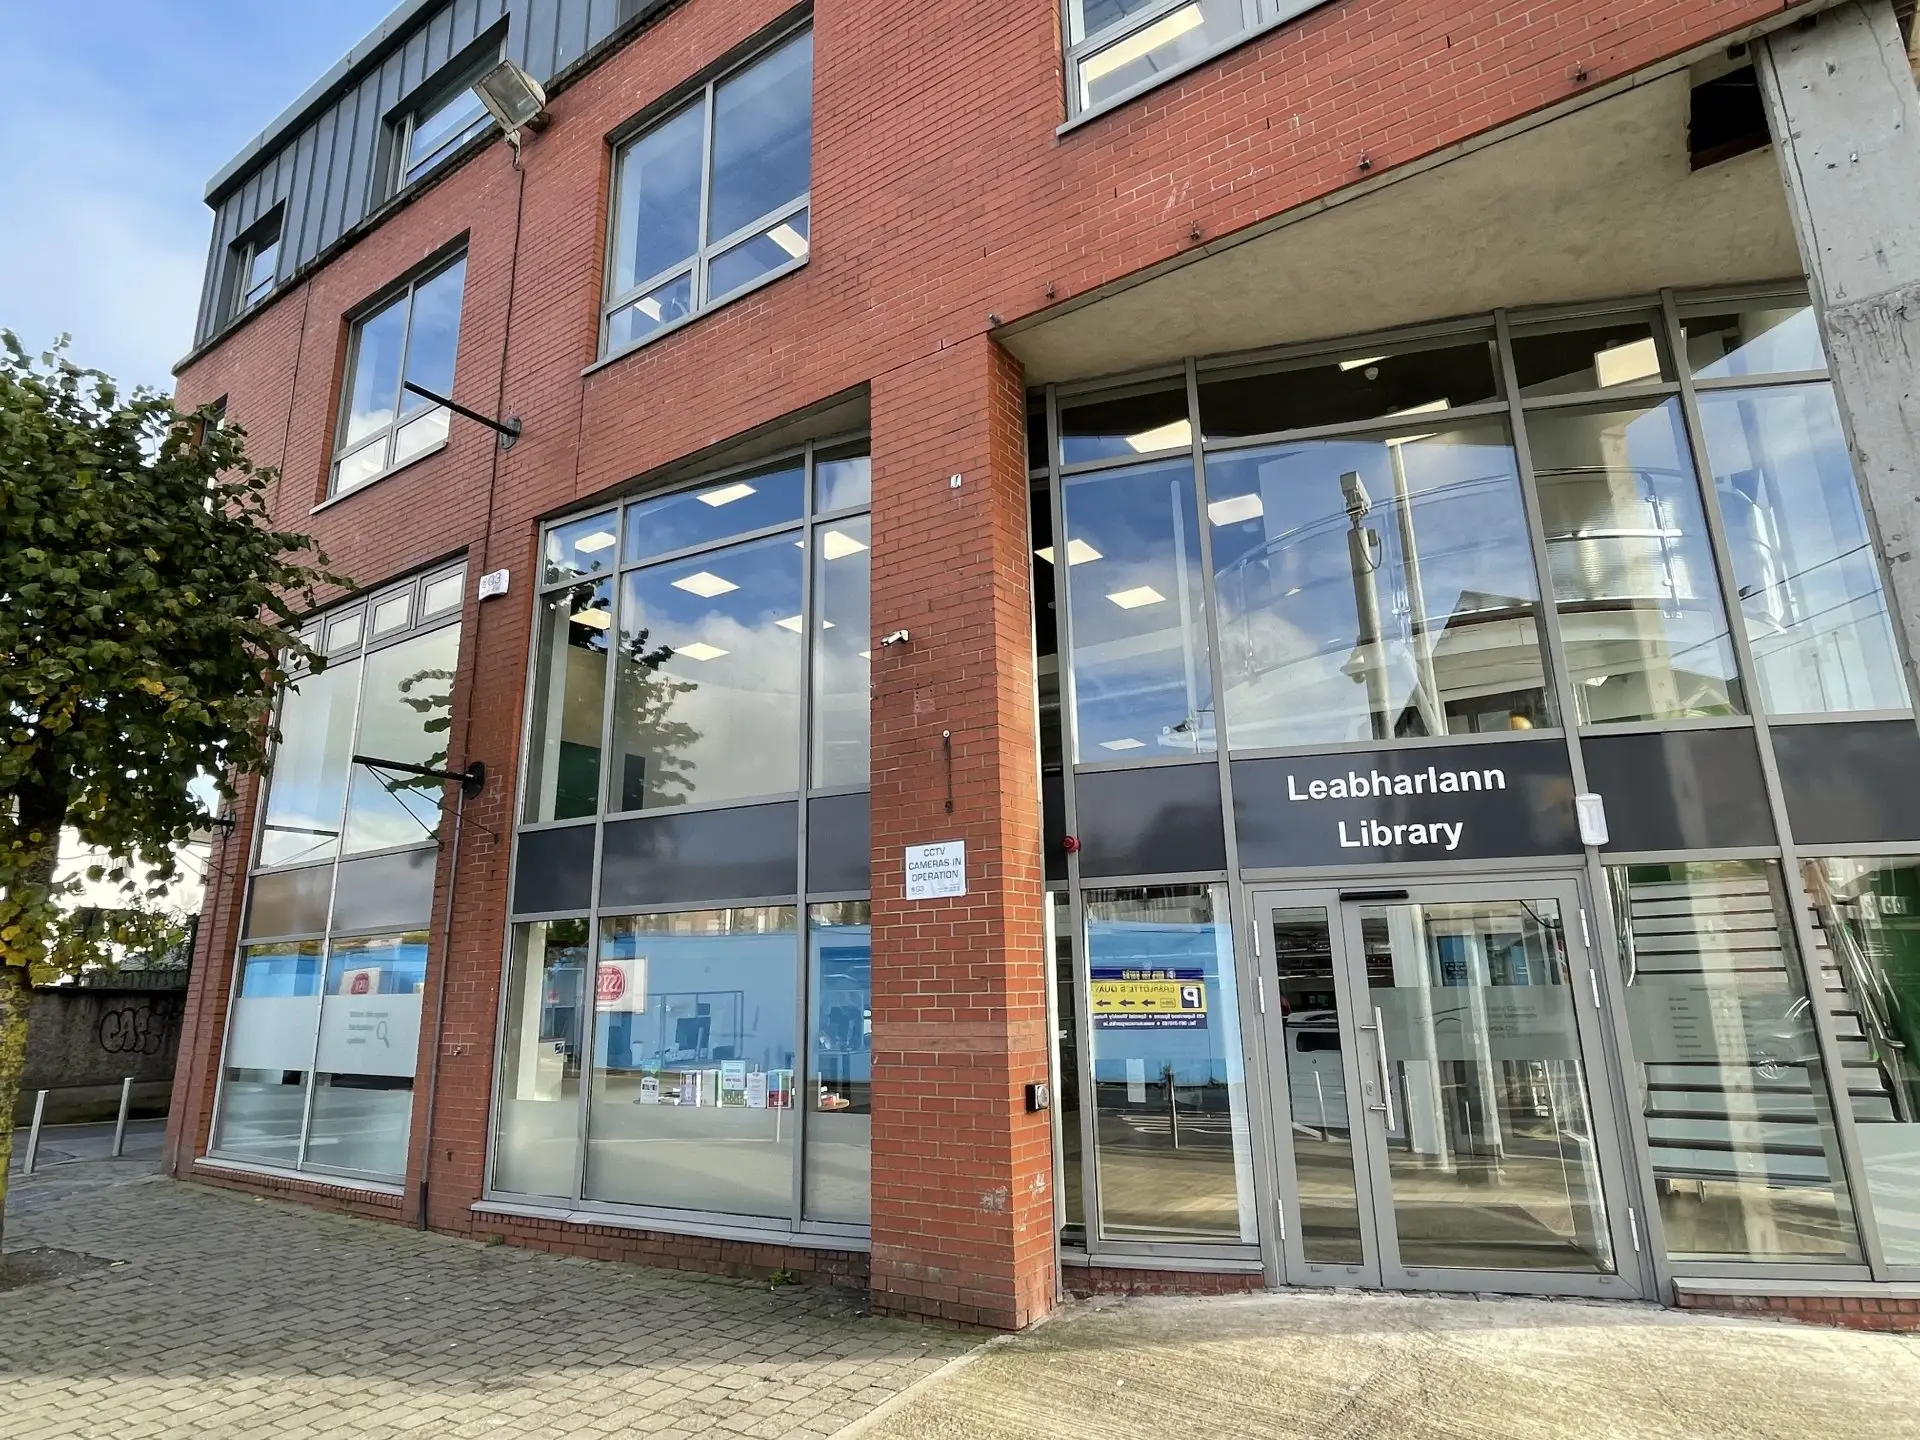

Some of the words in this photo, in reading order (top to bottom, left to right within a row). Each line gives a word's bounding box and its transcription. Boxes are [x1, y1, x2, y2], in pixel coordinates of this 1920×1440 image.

[1287, 767, 1506, 801] Leabharlann
[1337, 820, 1463, 851] Library
[923, 847, 946, 857] CCTV
[908, 859, 950, 870] CAMERAS
[952, 857, 962, 866] IN
[912, 870, 959, 882] OPERATION
